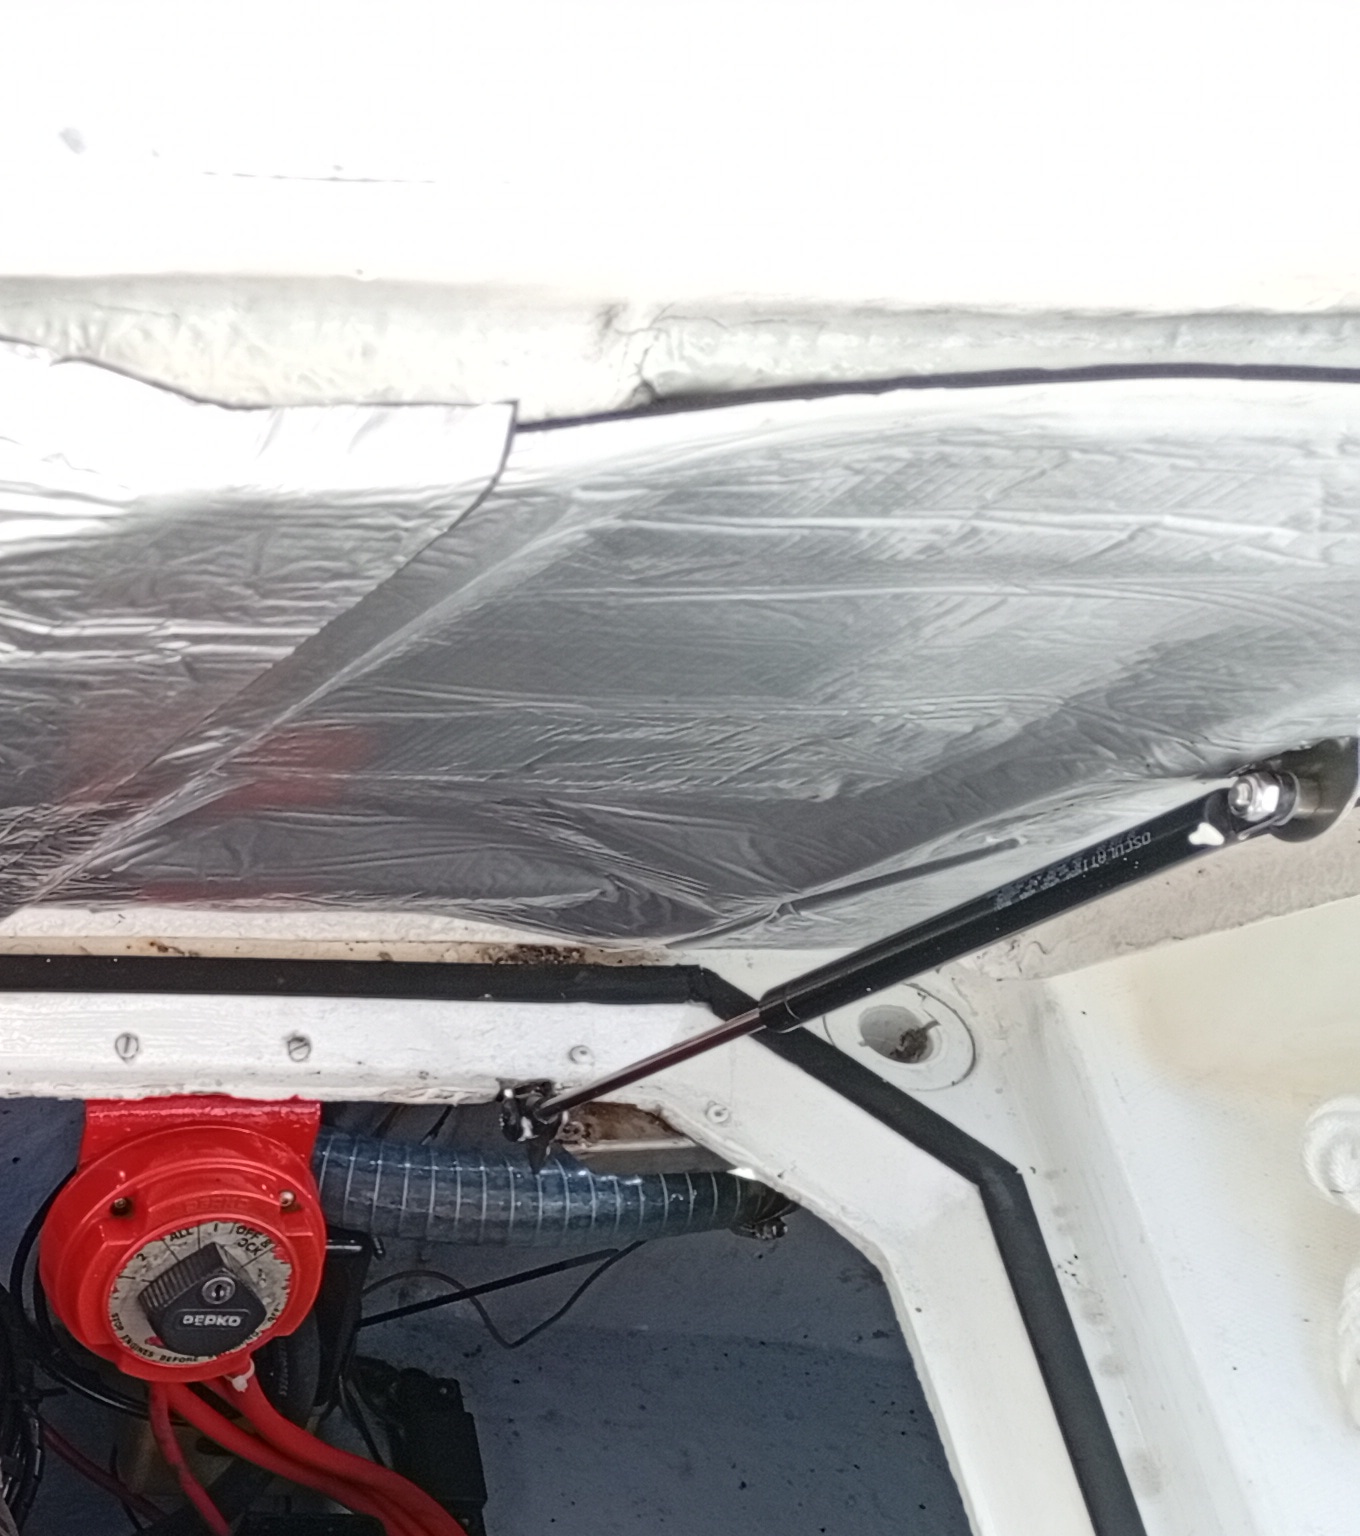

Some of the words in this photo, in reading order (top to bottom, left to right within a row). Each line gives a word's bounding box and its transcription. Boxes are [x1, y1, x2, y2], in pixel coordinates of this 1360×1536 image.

[169, 1229, 194, 1242] ALL
[236, 1226, 262, 1240] OFF
[111, 1312, 124, 1331] STOP
[182, 1314, 242, 1327] PERKO
